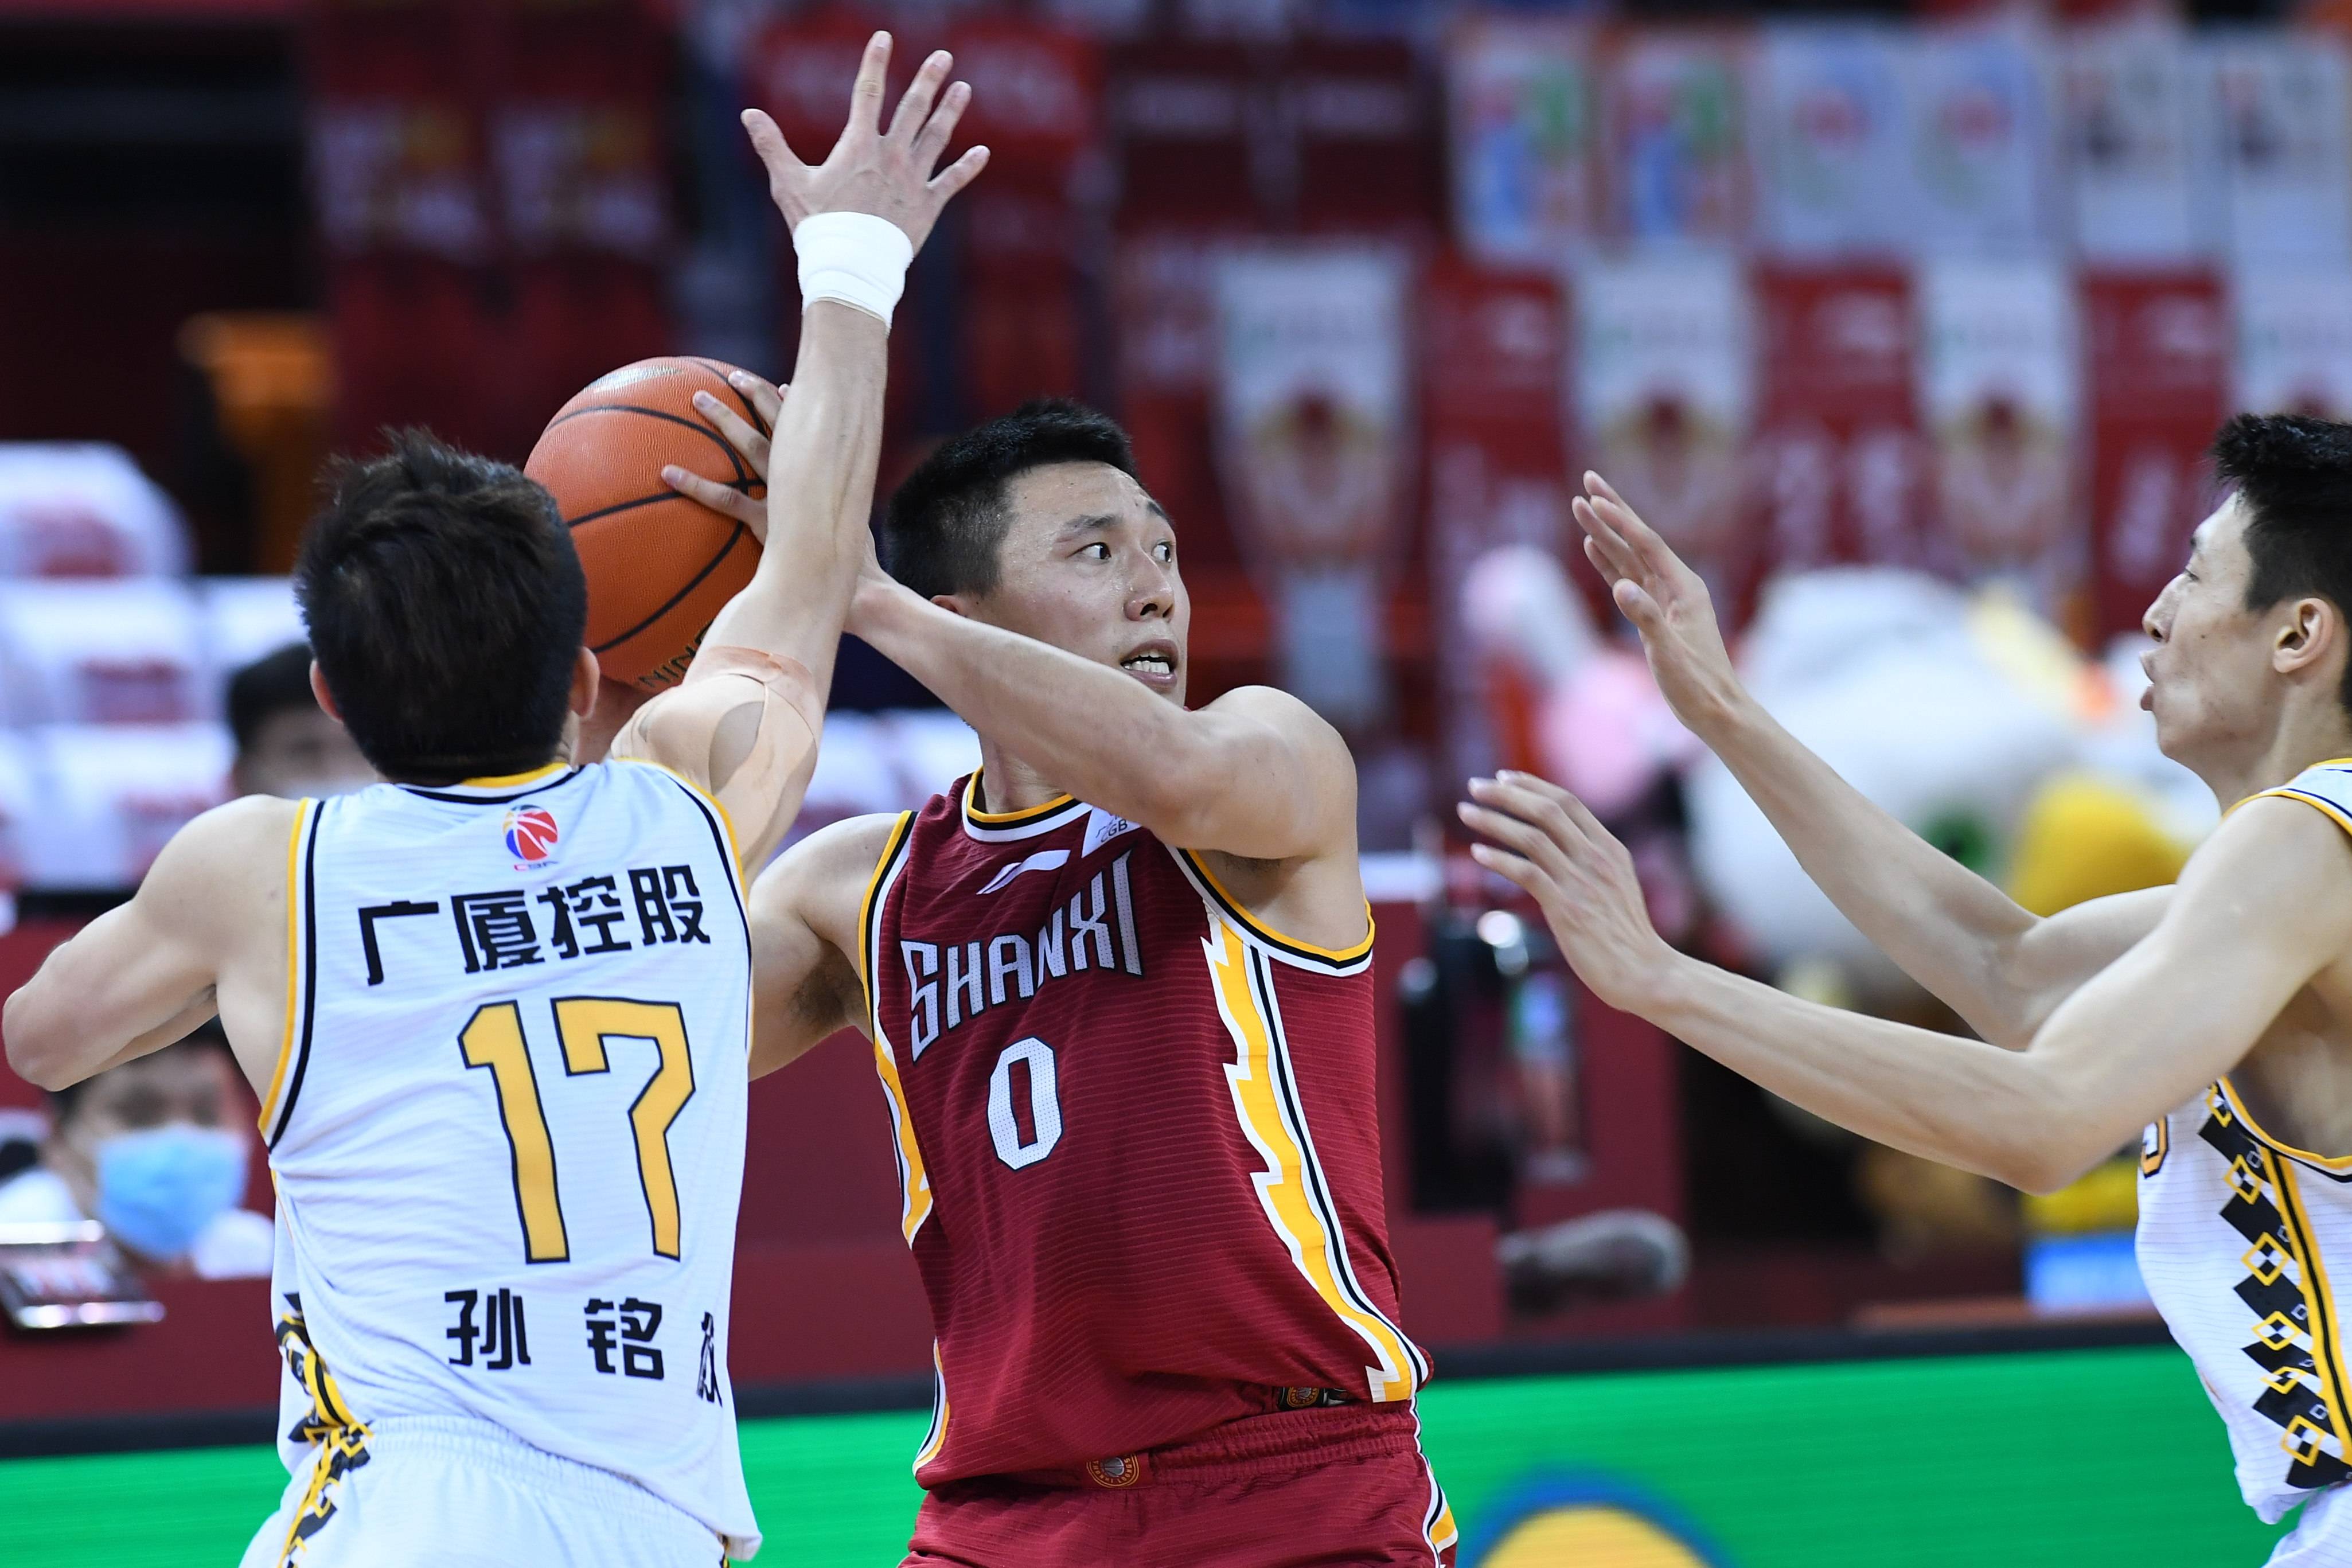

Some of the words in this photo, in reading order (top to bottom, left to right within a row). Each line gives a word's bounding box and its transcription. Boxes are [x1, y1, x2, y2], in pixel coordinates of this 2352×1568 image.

[358, 865, 710, 986] 广厦控股
[900, 850, 1142, 1063] SHANXI
[458, 995, 696, 1265] 17
[988, 1036, 1063, 1171] 0
